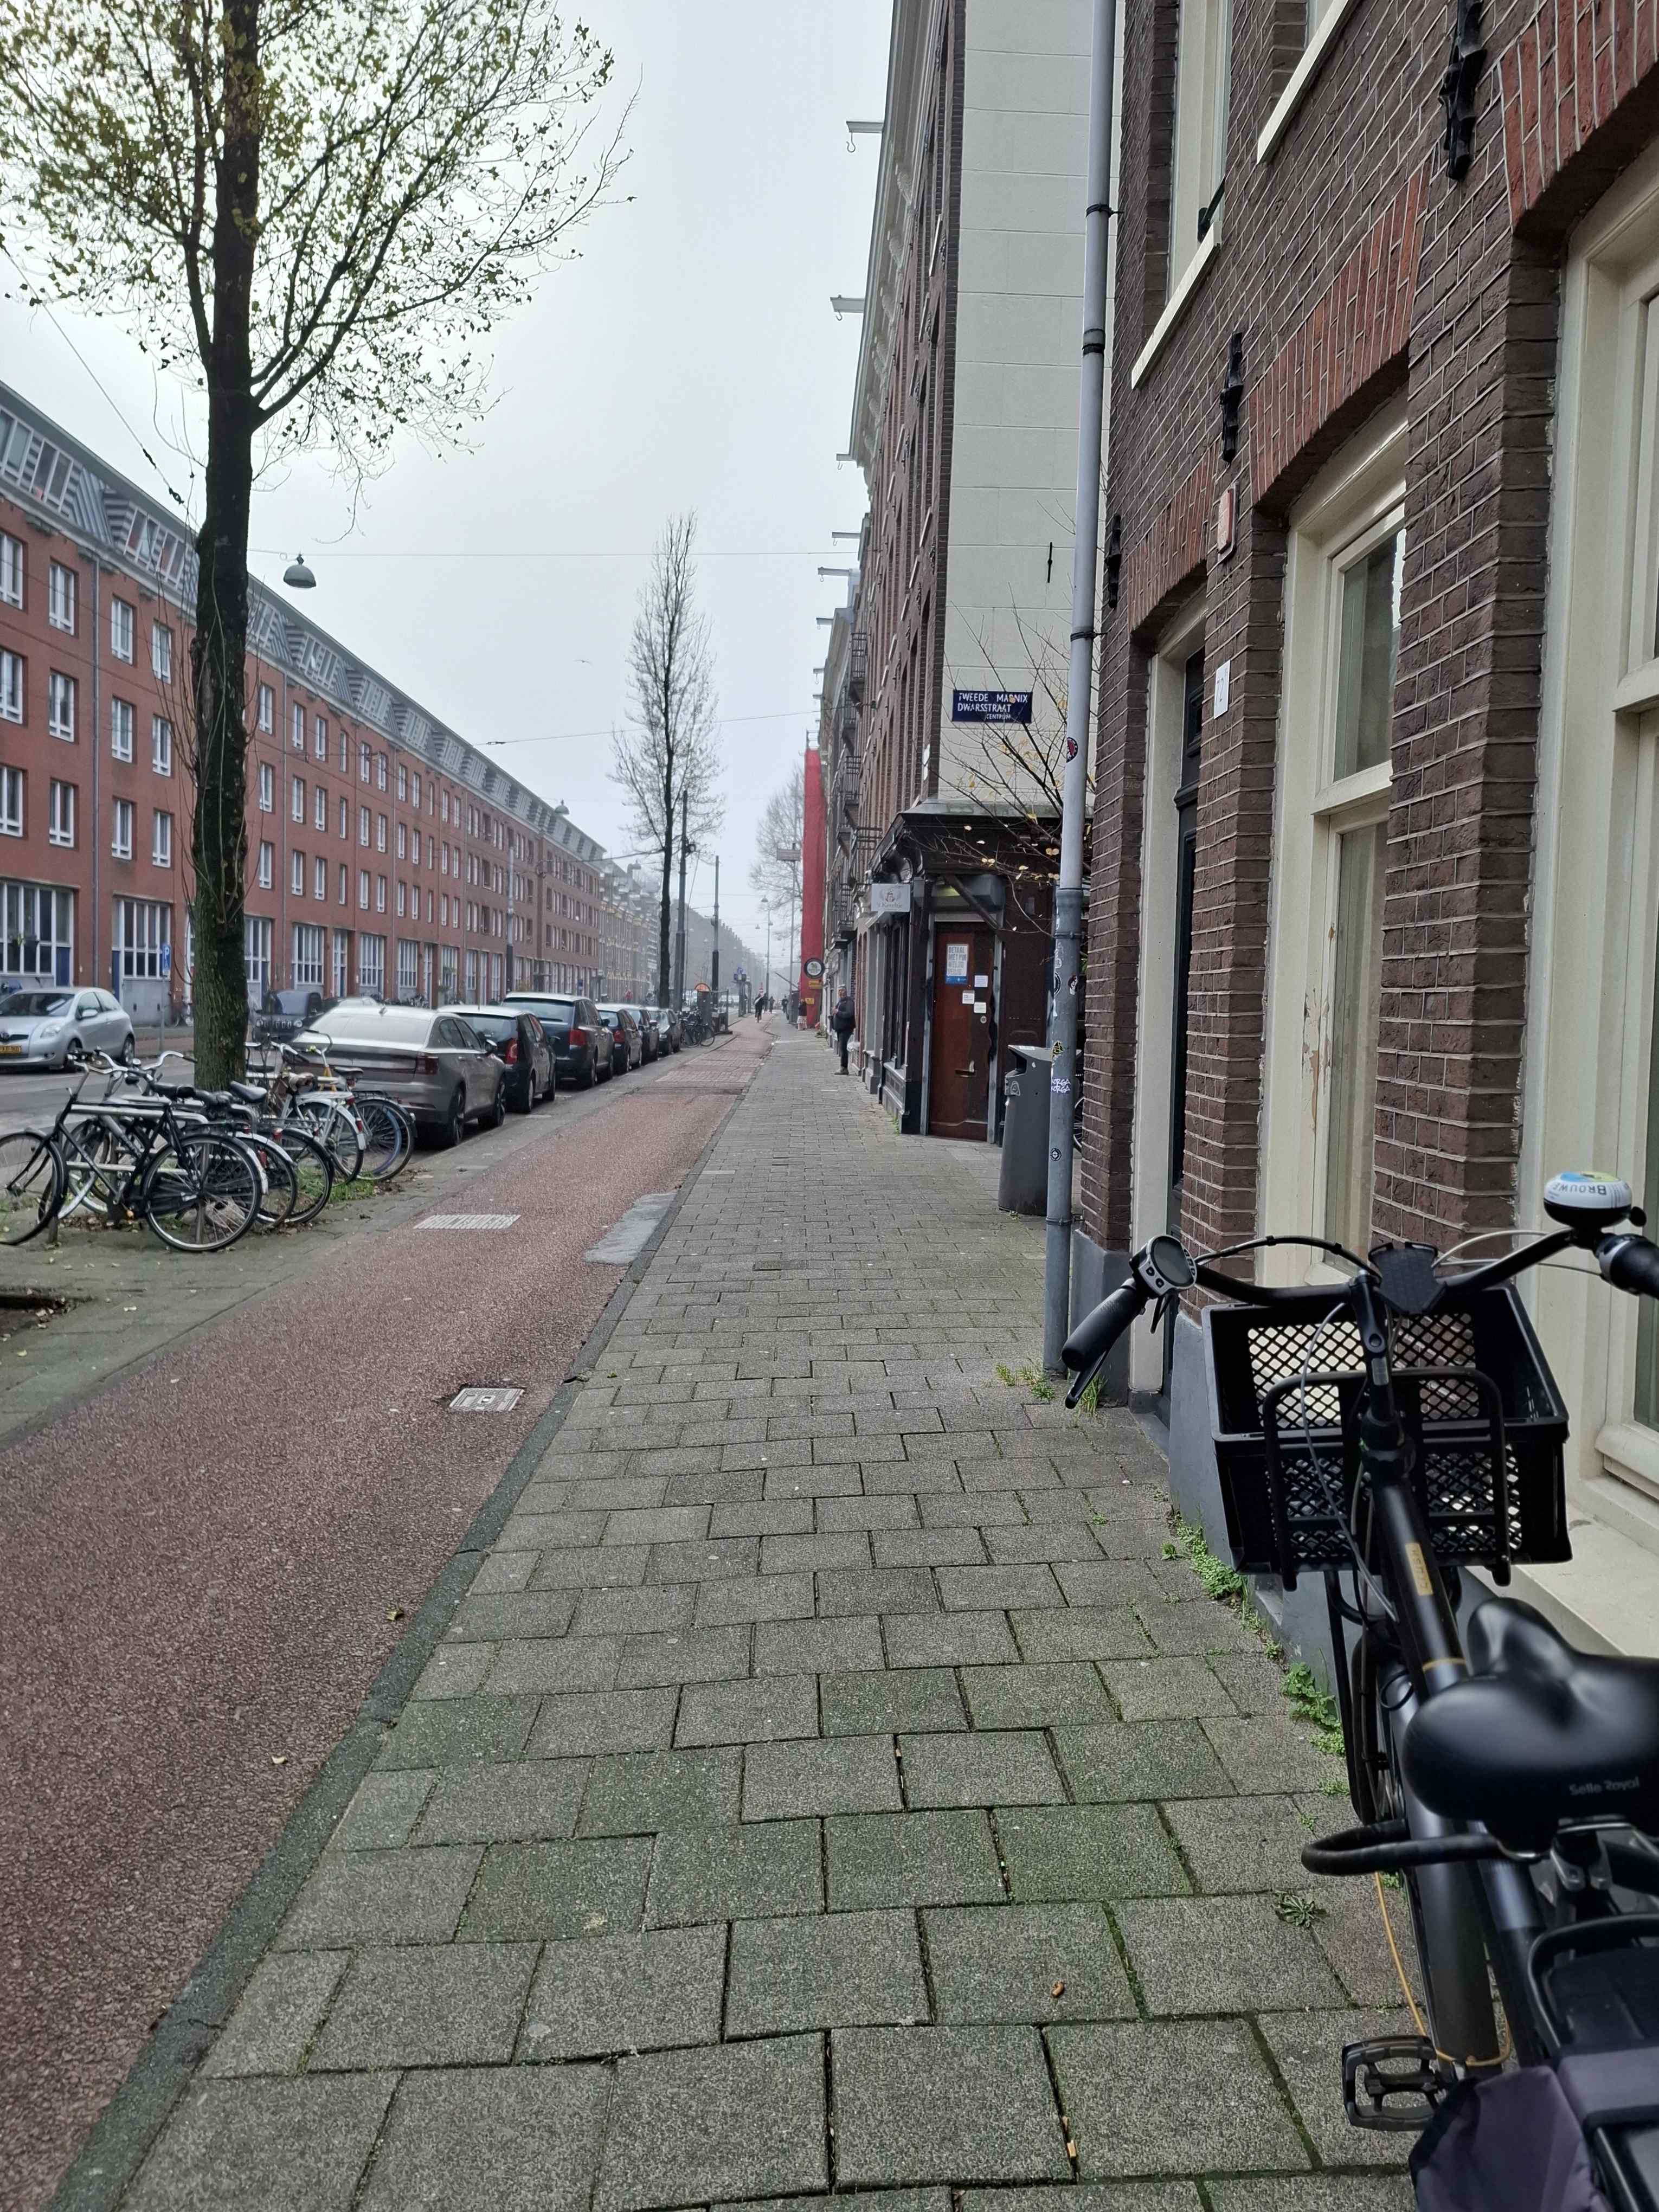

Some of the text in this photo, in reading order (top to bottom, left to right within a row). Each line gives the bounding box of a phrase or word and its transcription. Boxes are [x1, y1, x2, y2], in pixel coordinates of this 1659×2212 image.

[959, 693, 989, 702] TWEEDE
[957, 703, 1012, 712] DWARSSTRAAT
[1569, 1776, 1640, 1796] Selle Royal
